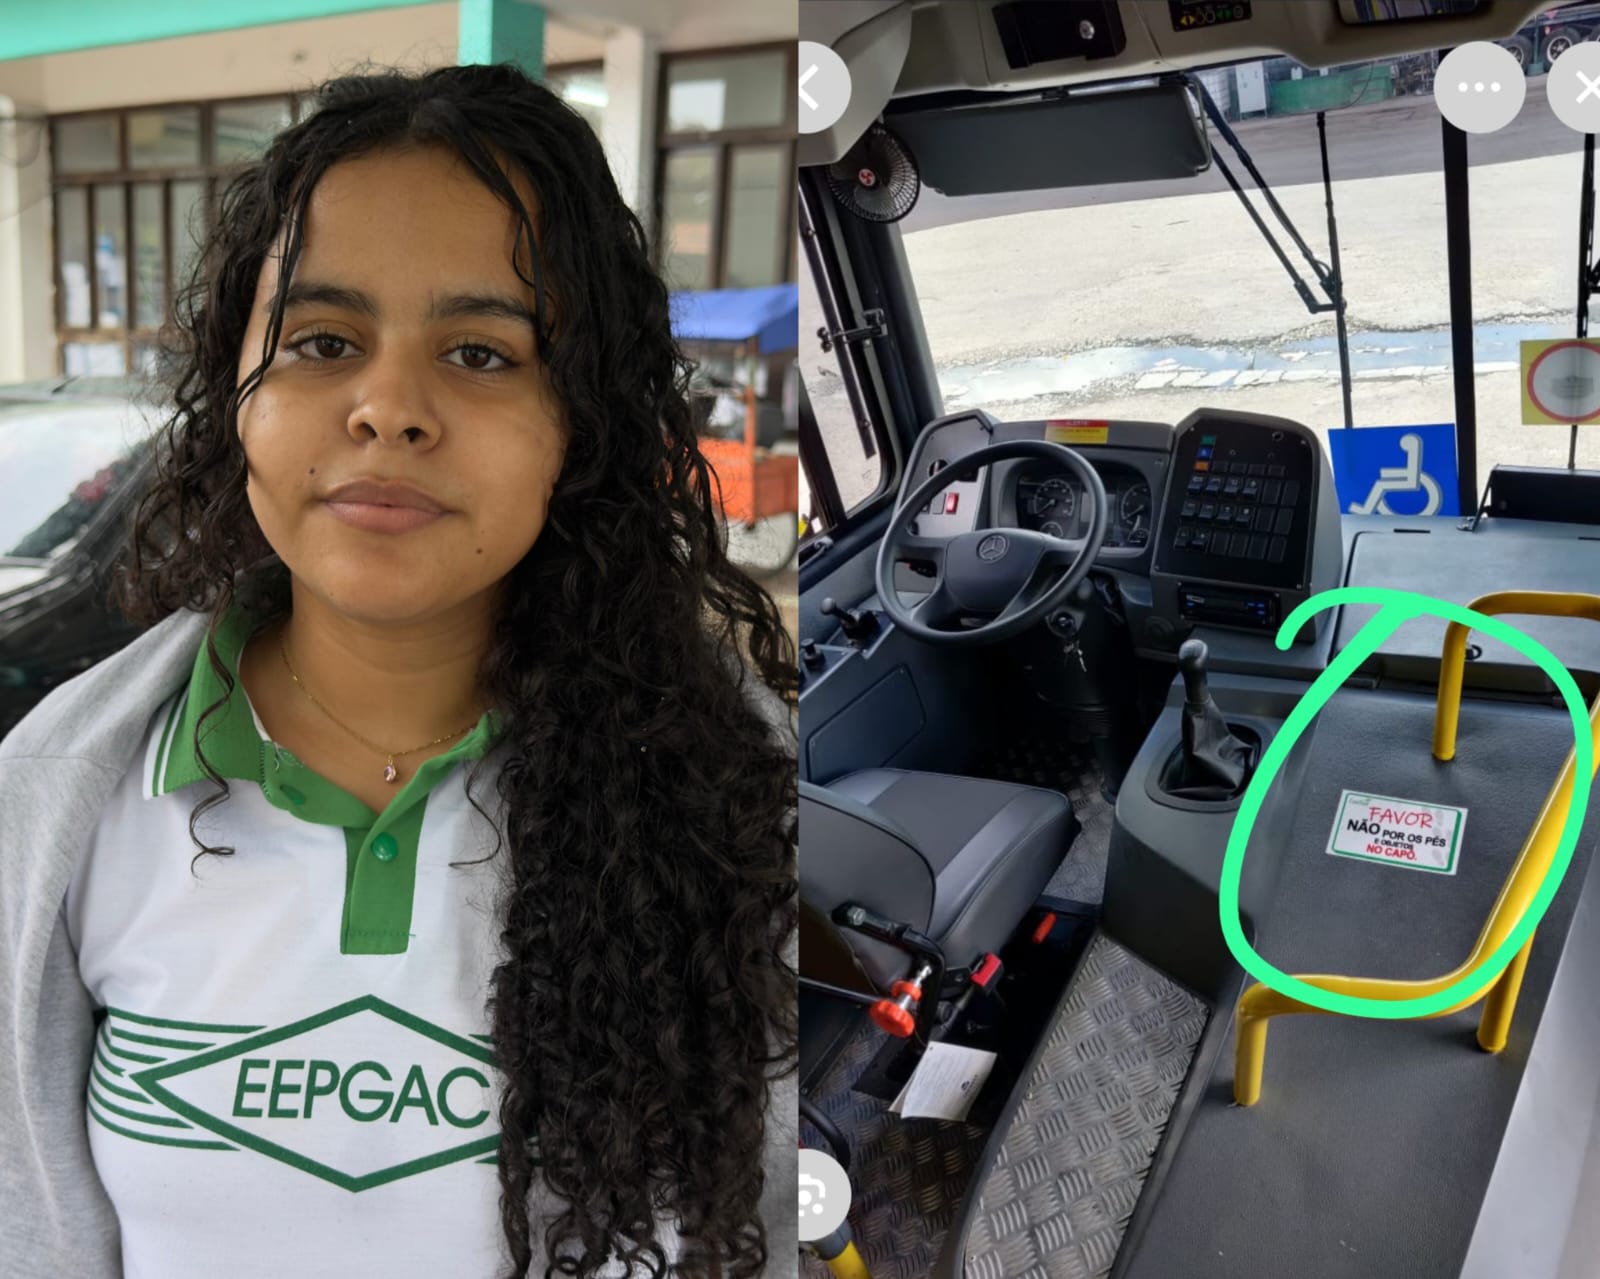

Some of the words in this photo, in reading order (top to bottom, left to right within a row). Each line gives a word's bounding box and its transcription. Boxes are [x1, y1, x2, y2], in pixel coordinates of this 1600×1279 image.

[1370, 806, 1432, 828] FAVOR
[1347, 819, 1380, 835] NÃO
[1382, 830, 1405, 841] POR
[1407, 833, 1422, 844] OS
[1425, 835, 1446, 847] PÉS
[1366, 844, 1383, 855] NO
[1381, 839, 1414, 850] OBJETOS
[232, 1058, 491, 1129] EEPGAC
